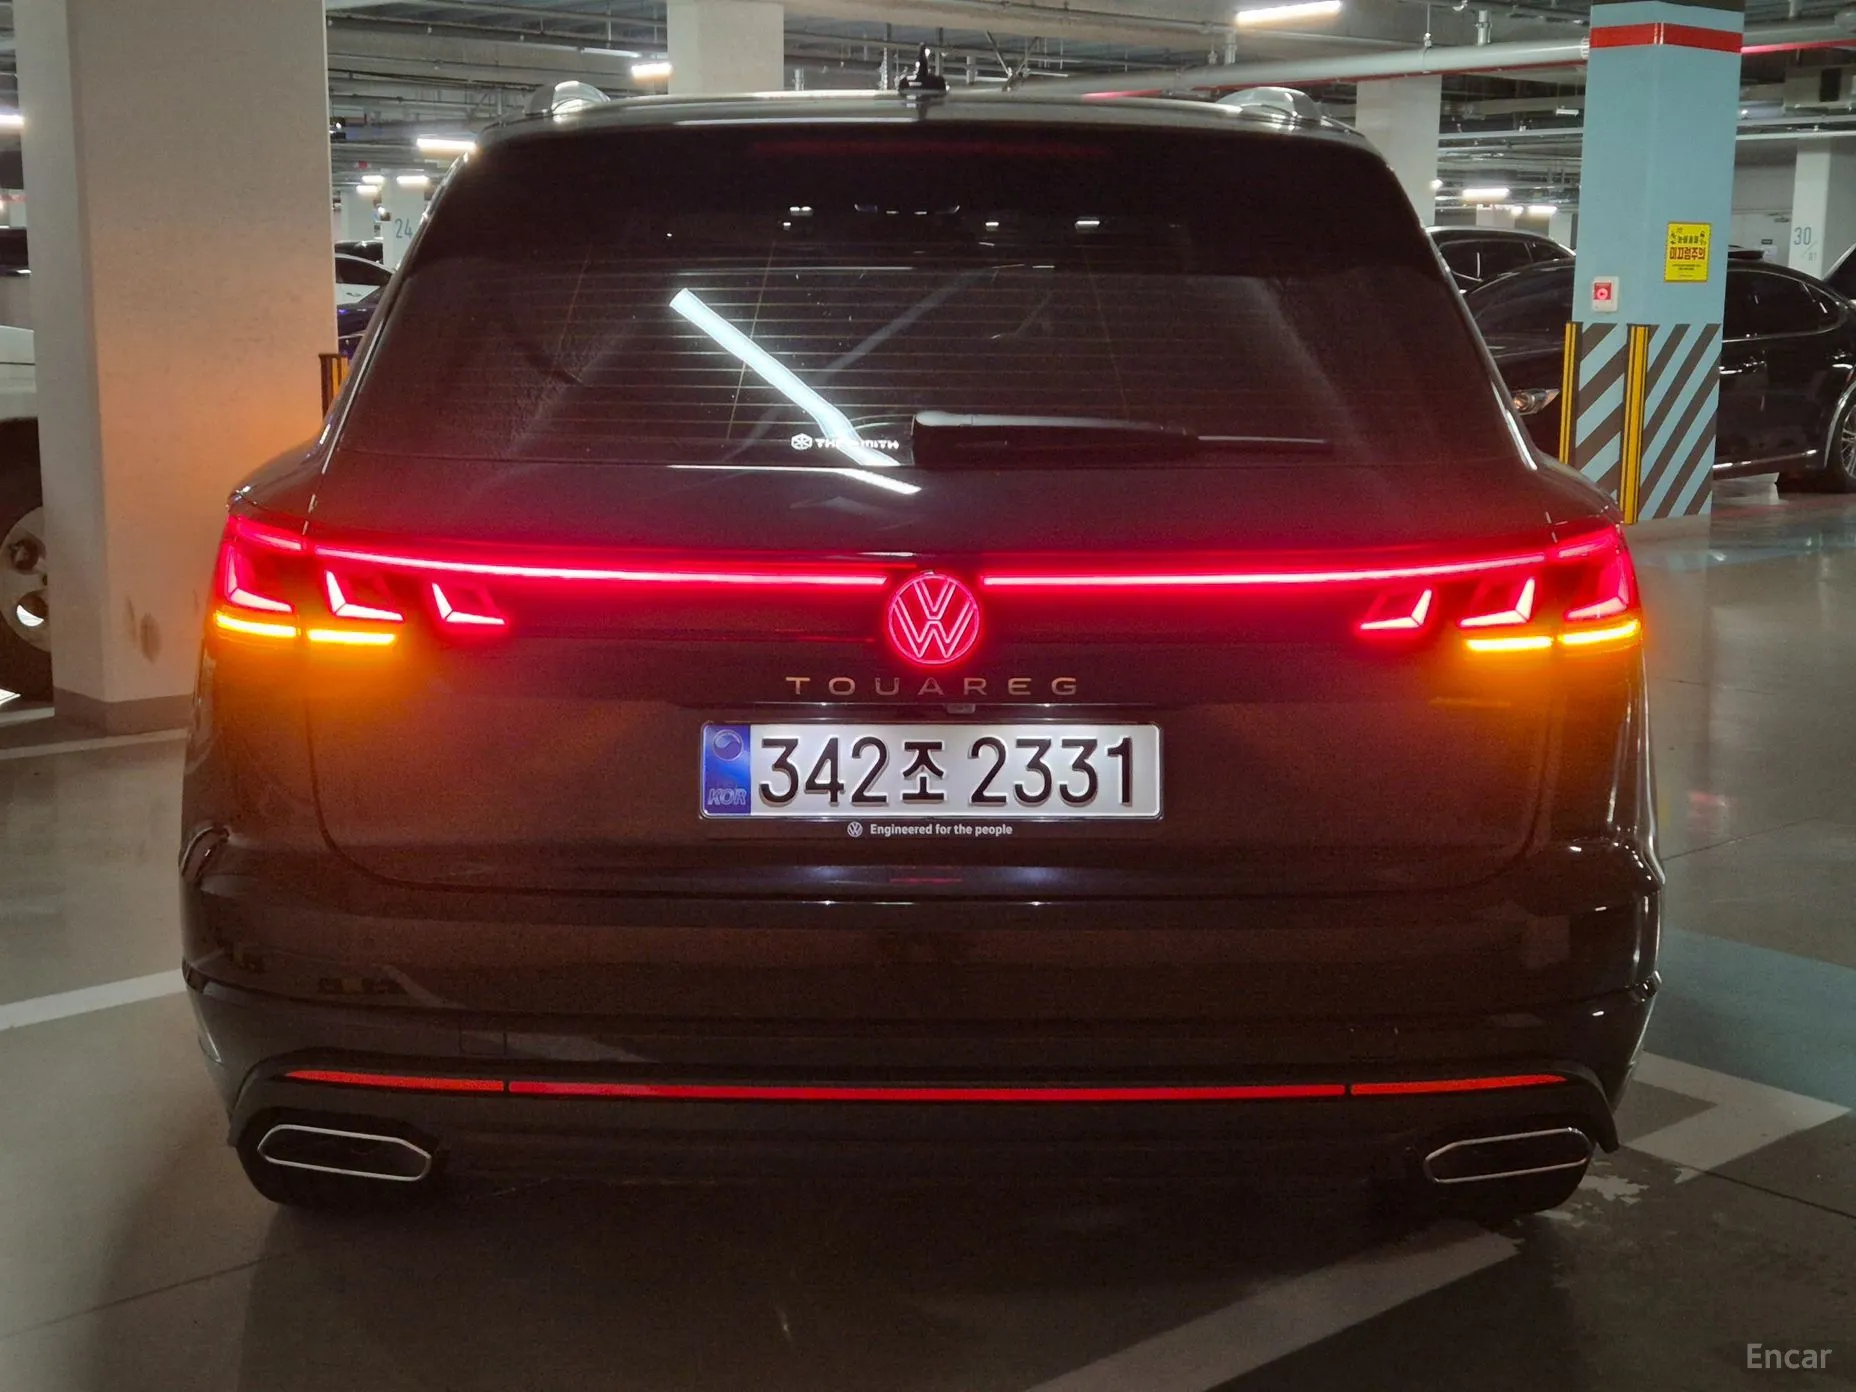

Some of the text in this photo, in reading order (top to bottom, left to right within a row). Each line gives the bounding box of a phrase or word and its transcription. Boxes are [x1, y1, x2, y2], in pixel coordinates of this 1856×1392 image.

[395, 218, 413, 239] 24
[1793, 226, 1812, 246] 30
[889, 574, 979, 664] VW
[786, 676, 1077, 696] TOUAREG
[968, 736, 1133, 806] 2331
[708, 788, 747, 806] KOR
[870, 823, 933, 837] Engineered
[935, 823, 951, 834] for
[954, 824, 972, 834] the
[975, 823, 1013, 837] people
